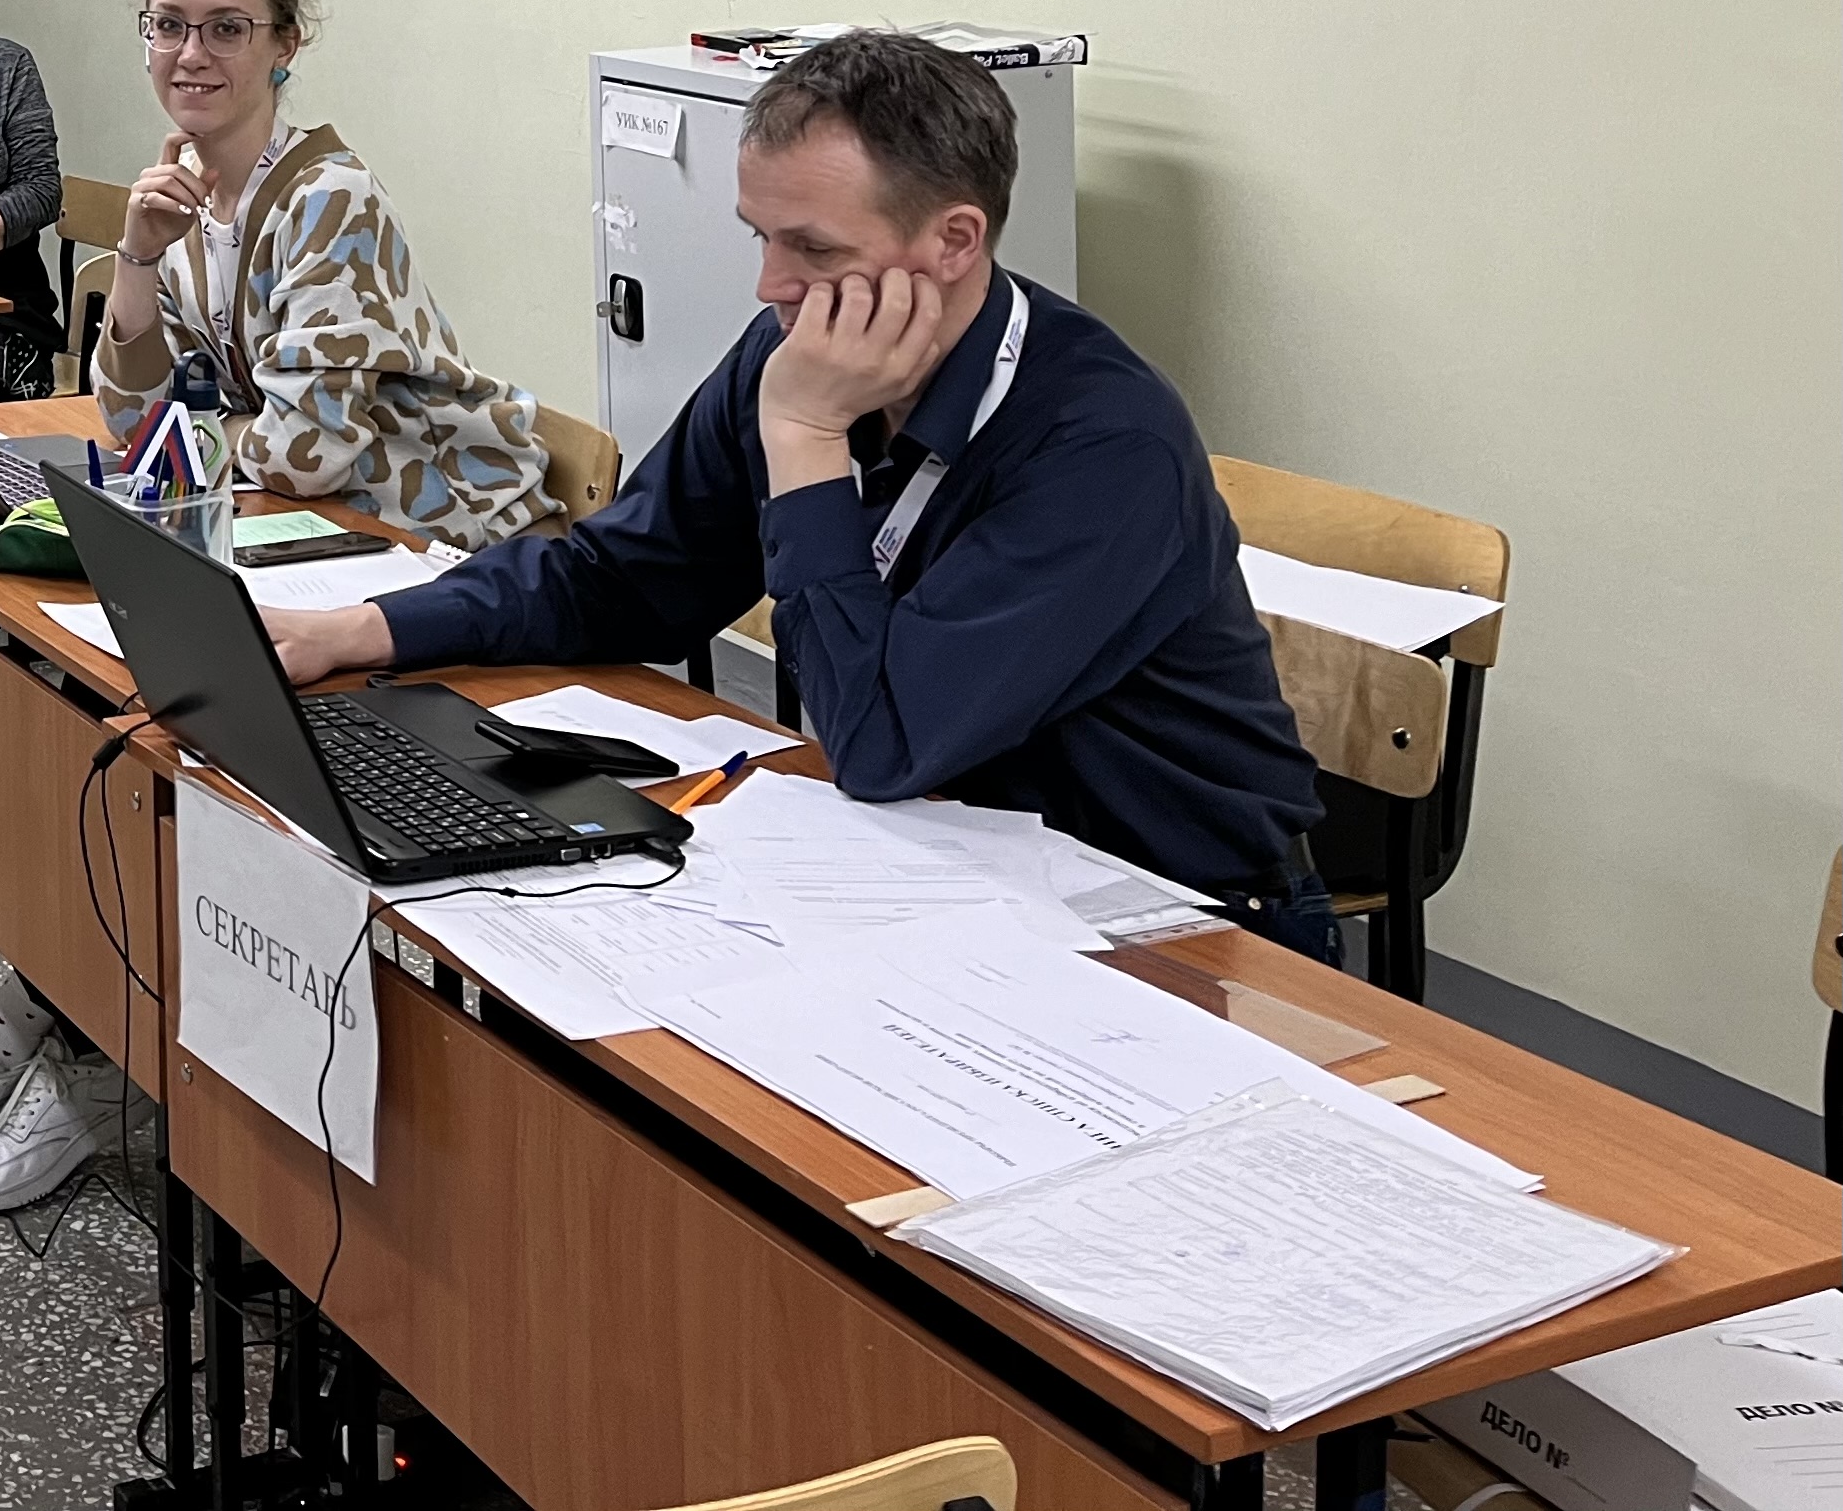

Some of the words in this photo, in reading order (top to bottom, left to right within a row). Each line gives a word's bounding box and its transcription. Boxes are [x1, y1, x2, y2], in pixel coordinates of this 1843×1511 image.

[616, 112, 640, 130] УИК
[1735, 1403, 1817, 1422] ДЕЛО
[1480, 1400, 1543, 1455] ДЕЛО
